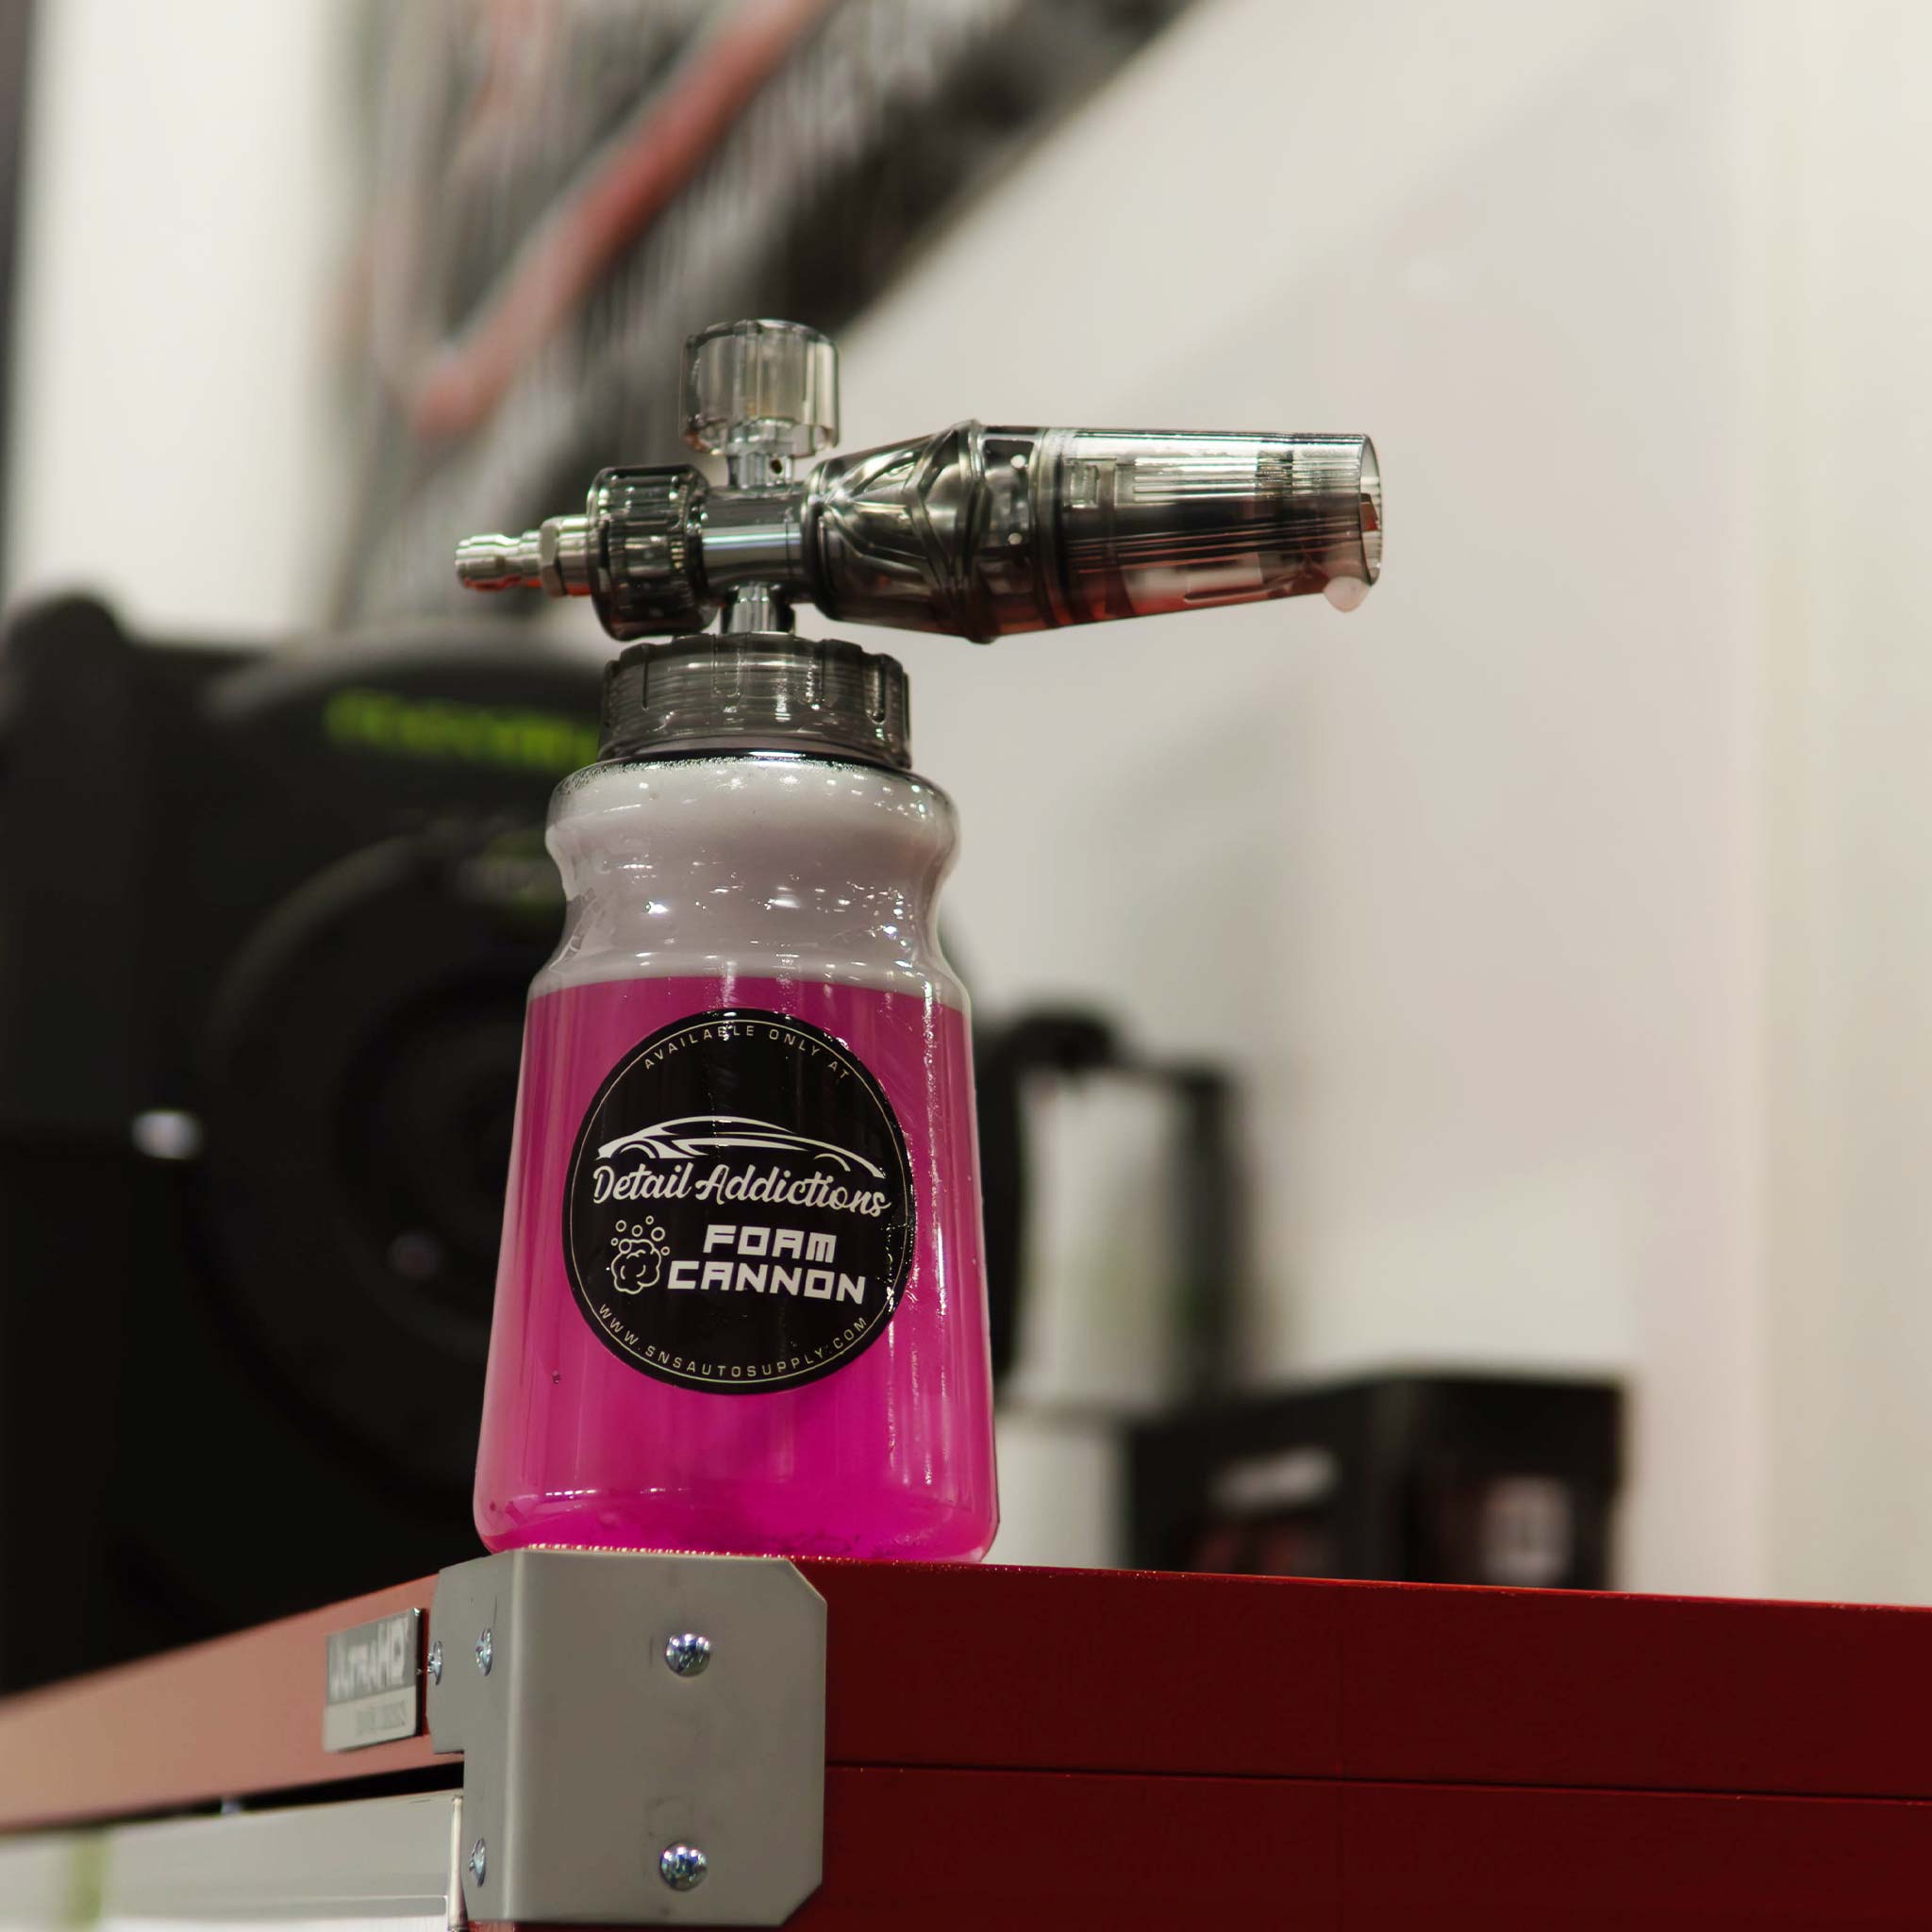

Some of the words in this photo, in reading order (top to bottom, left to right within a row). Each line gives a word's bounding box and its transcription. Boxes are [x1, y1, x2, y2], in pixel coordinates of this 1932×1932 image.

[644, 1024, 755, 1070] AVAILABLE
[769, 1028, 821, 1057] ONLY
[828, 1060, 849, 1079] AT
[592, 1162, 693, 1204] Detail
[695, 1164, 891, 1218] Addictions
[703, 1224, 837, 1263] FOAM
[667, 1260, 866, 1305] CANNON
[599, 1304, 867, 1377] WWW.SNSAUTOSUPPLY.COM
